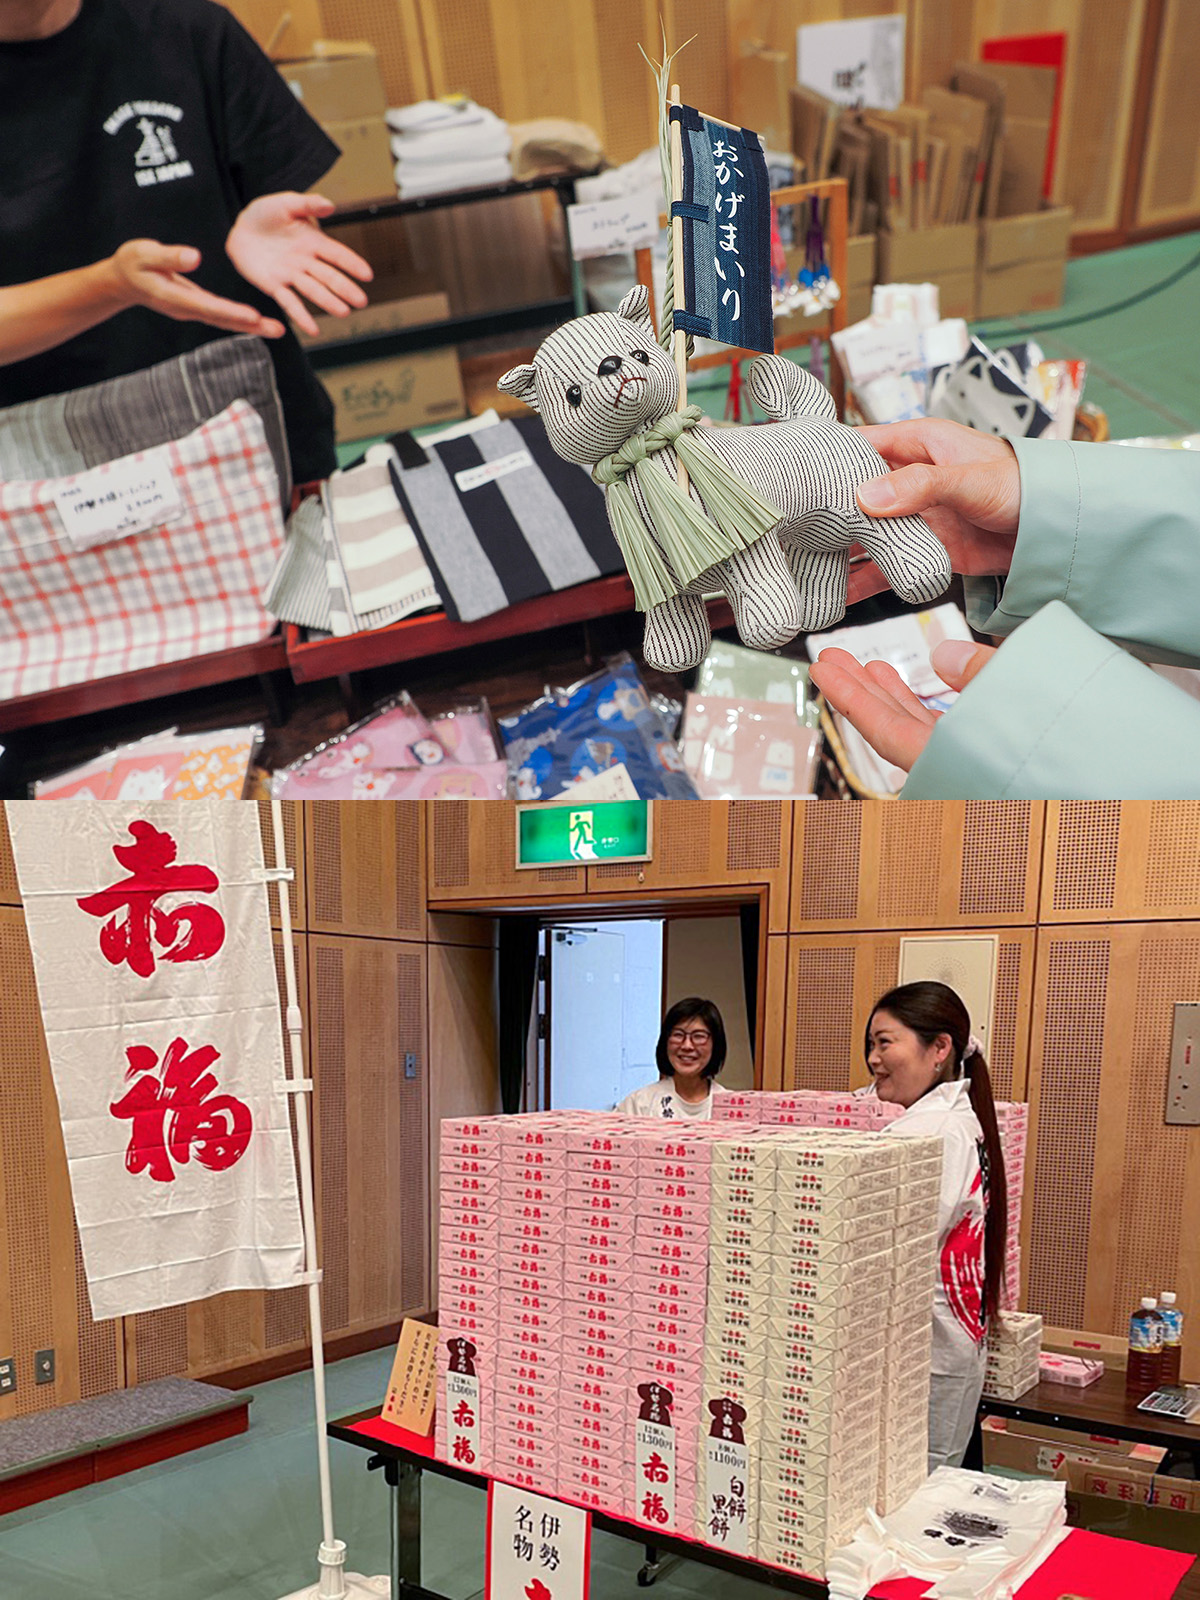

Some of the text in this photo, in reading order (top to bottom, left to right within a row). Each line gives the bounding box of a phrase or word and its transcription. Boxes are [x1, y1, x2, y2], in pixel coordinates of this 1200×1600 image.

[711, 139, 745, 322] おかげまいり
[77, 819, 253, 1183] 赤福
[452, 1399, 476, 1464] 赤福
[641, 1452, 669, 1524] 赤福
[708, 1493, 731, 1543] 黒餅
[726, 1475, 747, 1525] 白餅
[513, 1504, 534, 1562] 名物
[540, 1512, 561, 1571] 伊勢
